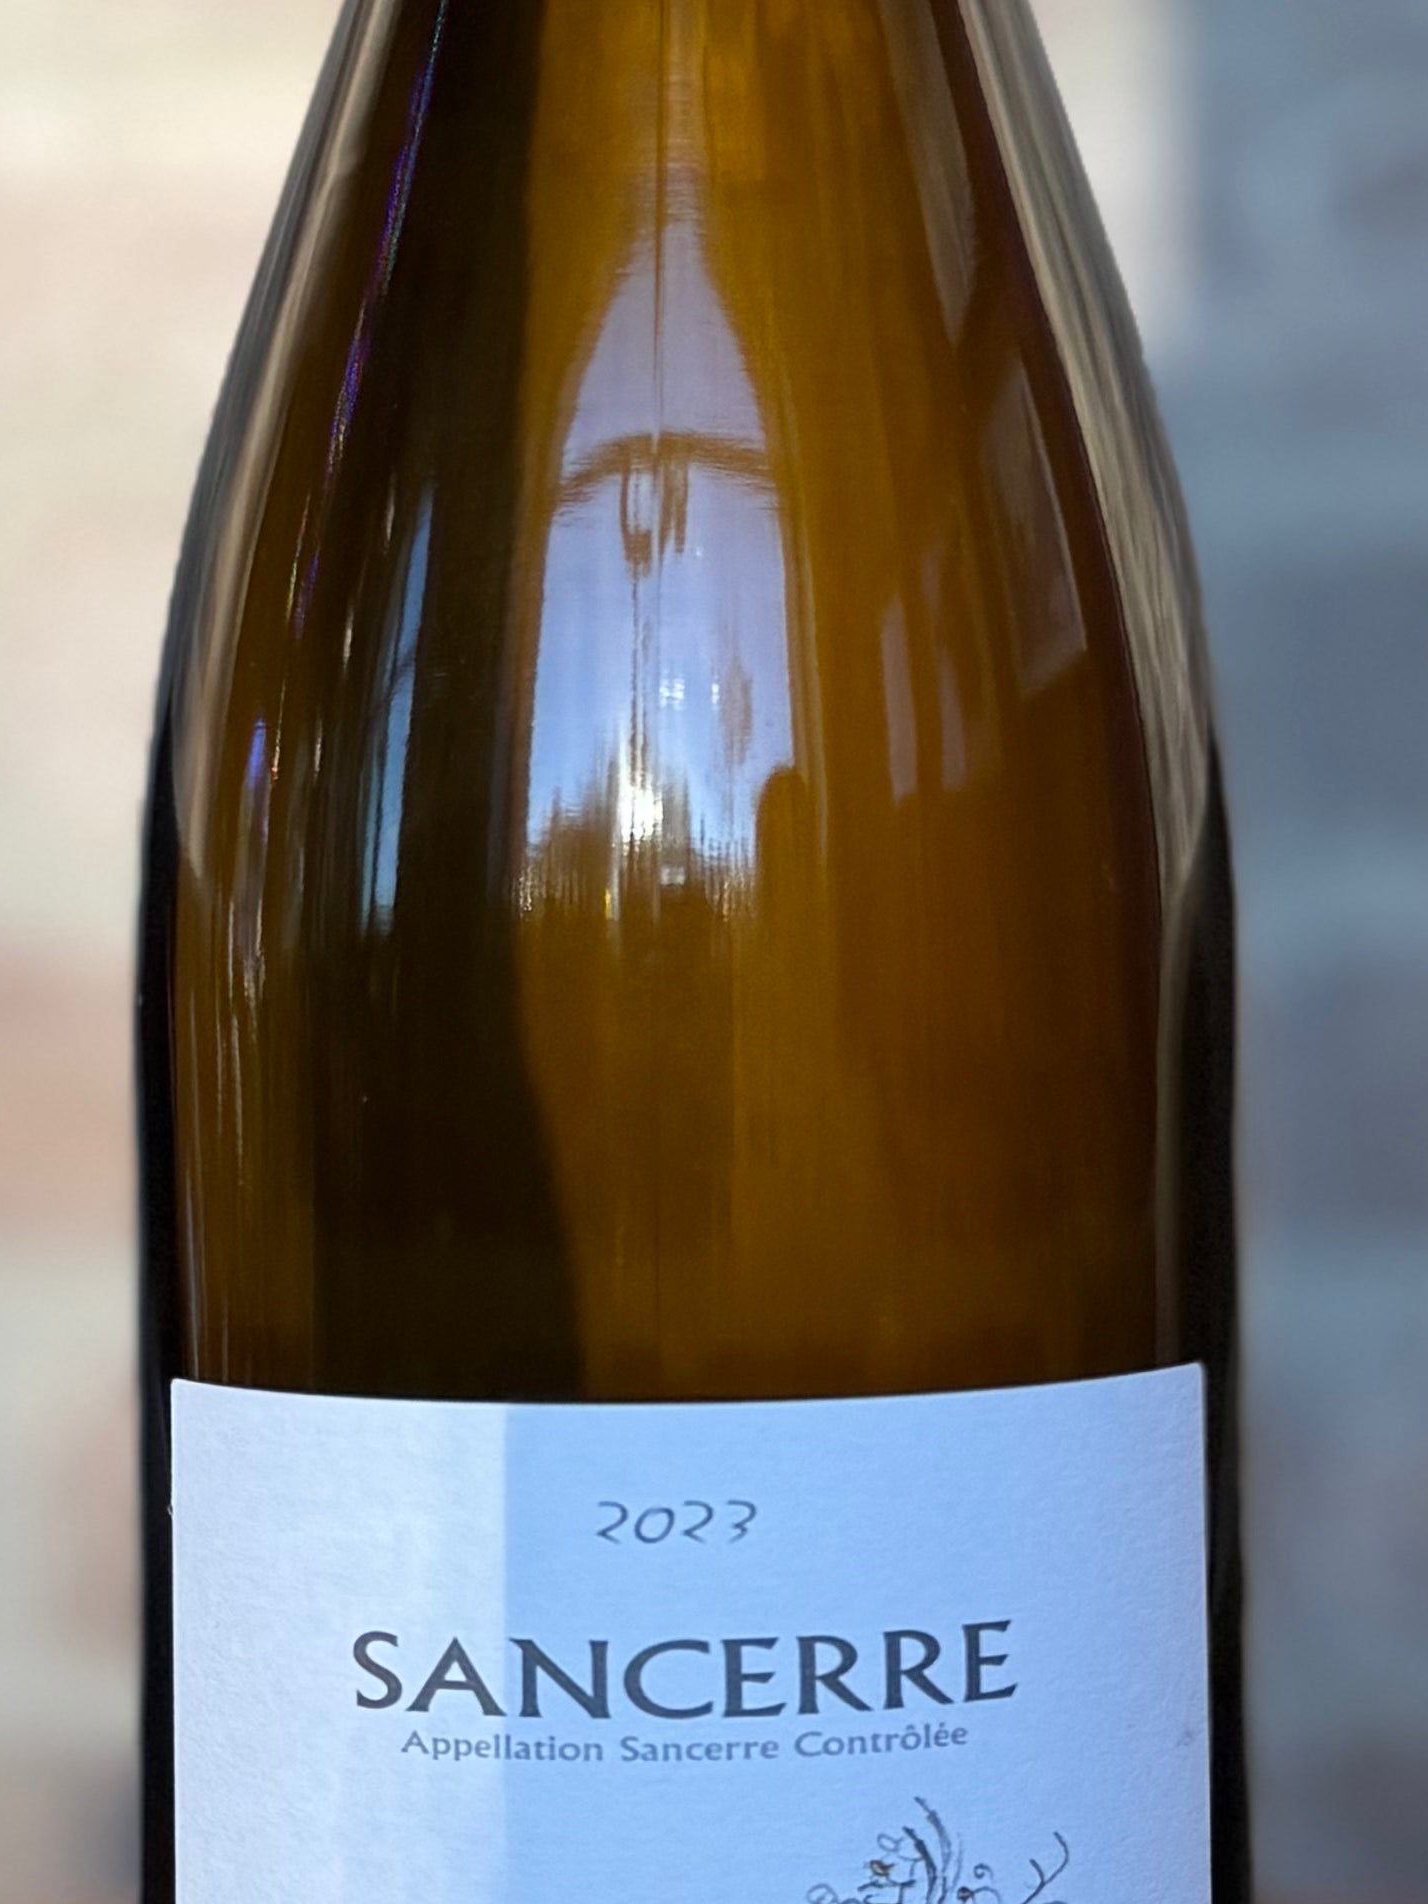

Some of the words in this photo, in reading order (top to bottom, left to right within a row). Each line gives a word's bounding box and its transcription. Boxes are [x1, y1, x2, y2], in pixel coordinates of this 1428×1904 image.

[594, 1499, 759, 1545] 2023
[351, 1618, 1019, 1721] SANCERRE
[400, 1730, 604, 1764] Appellation
[620, 1734, 780, 1763] Sancerre
[794, 1721, 969, 1759] Contrôlée
